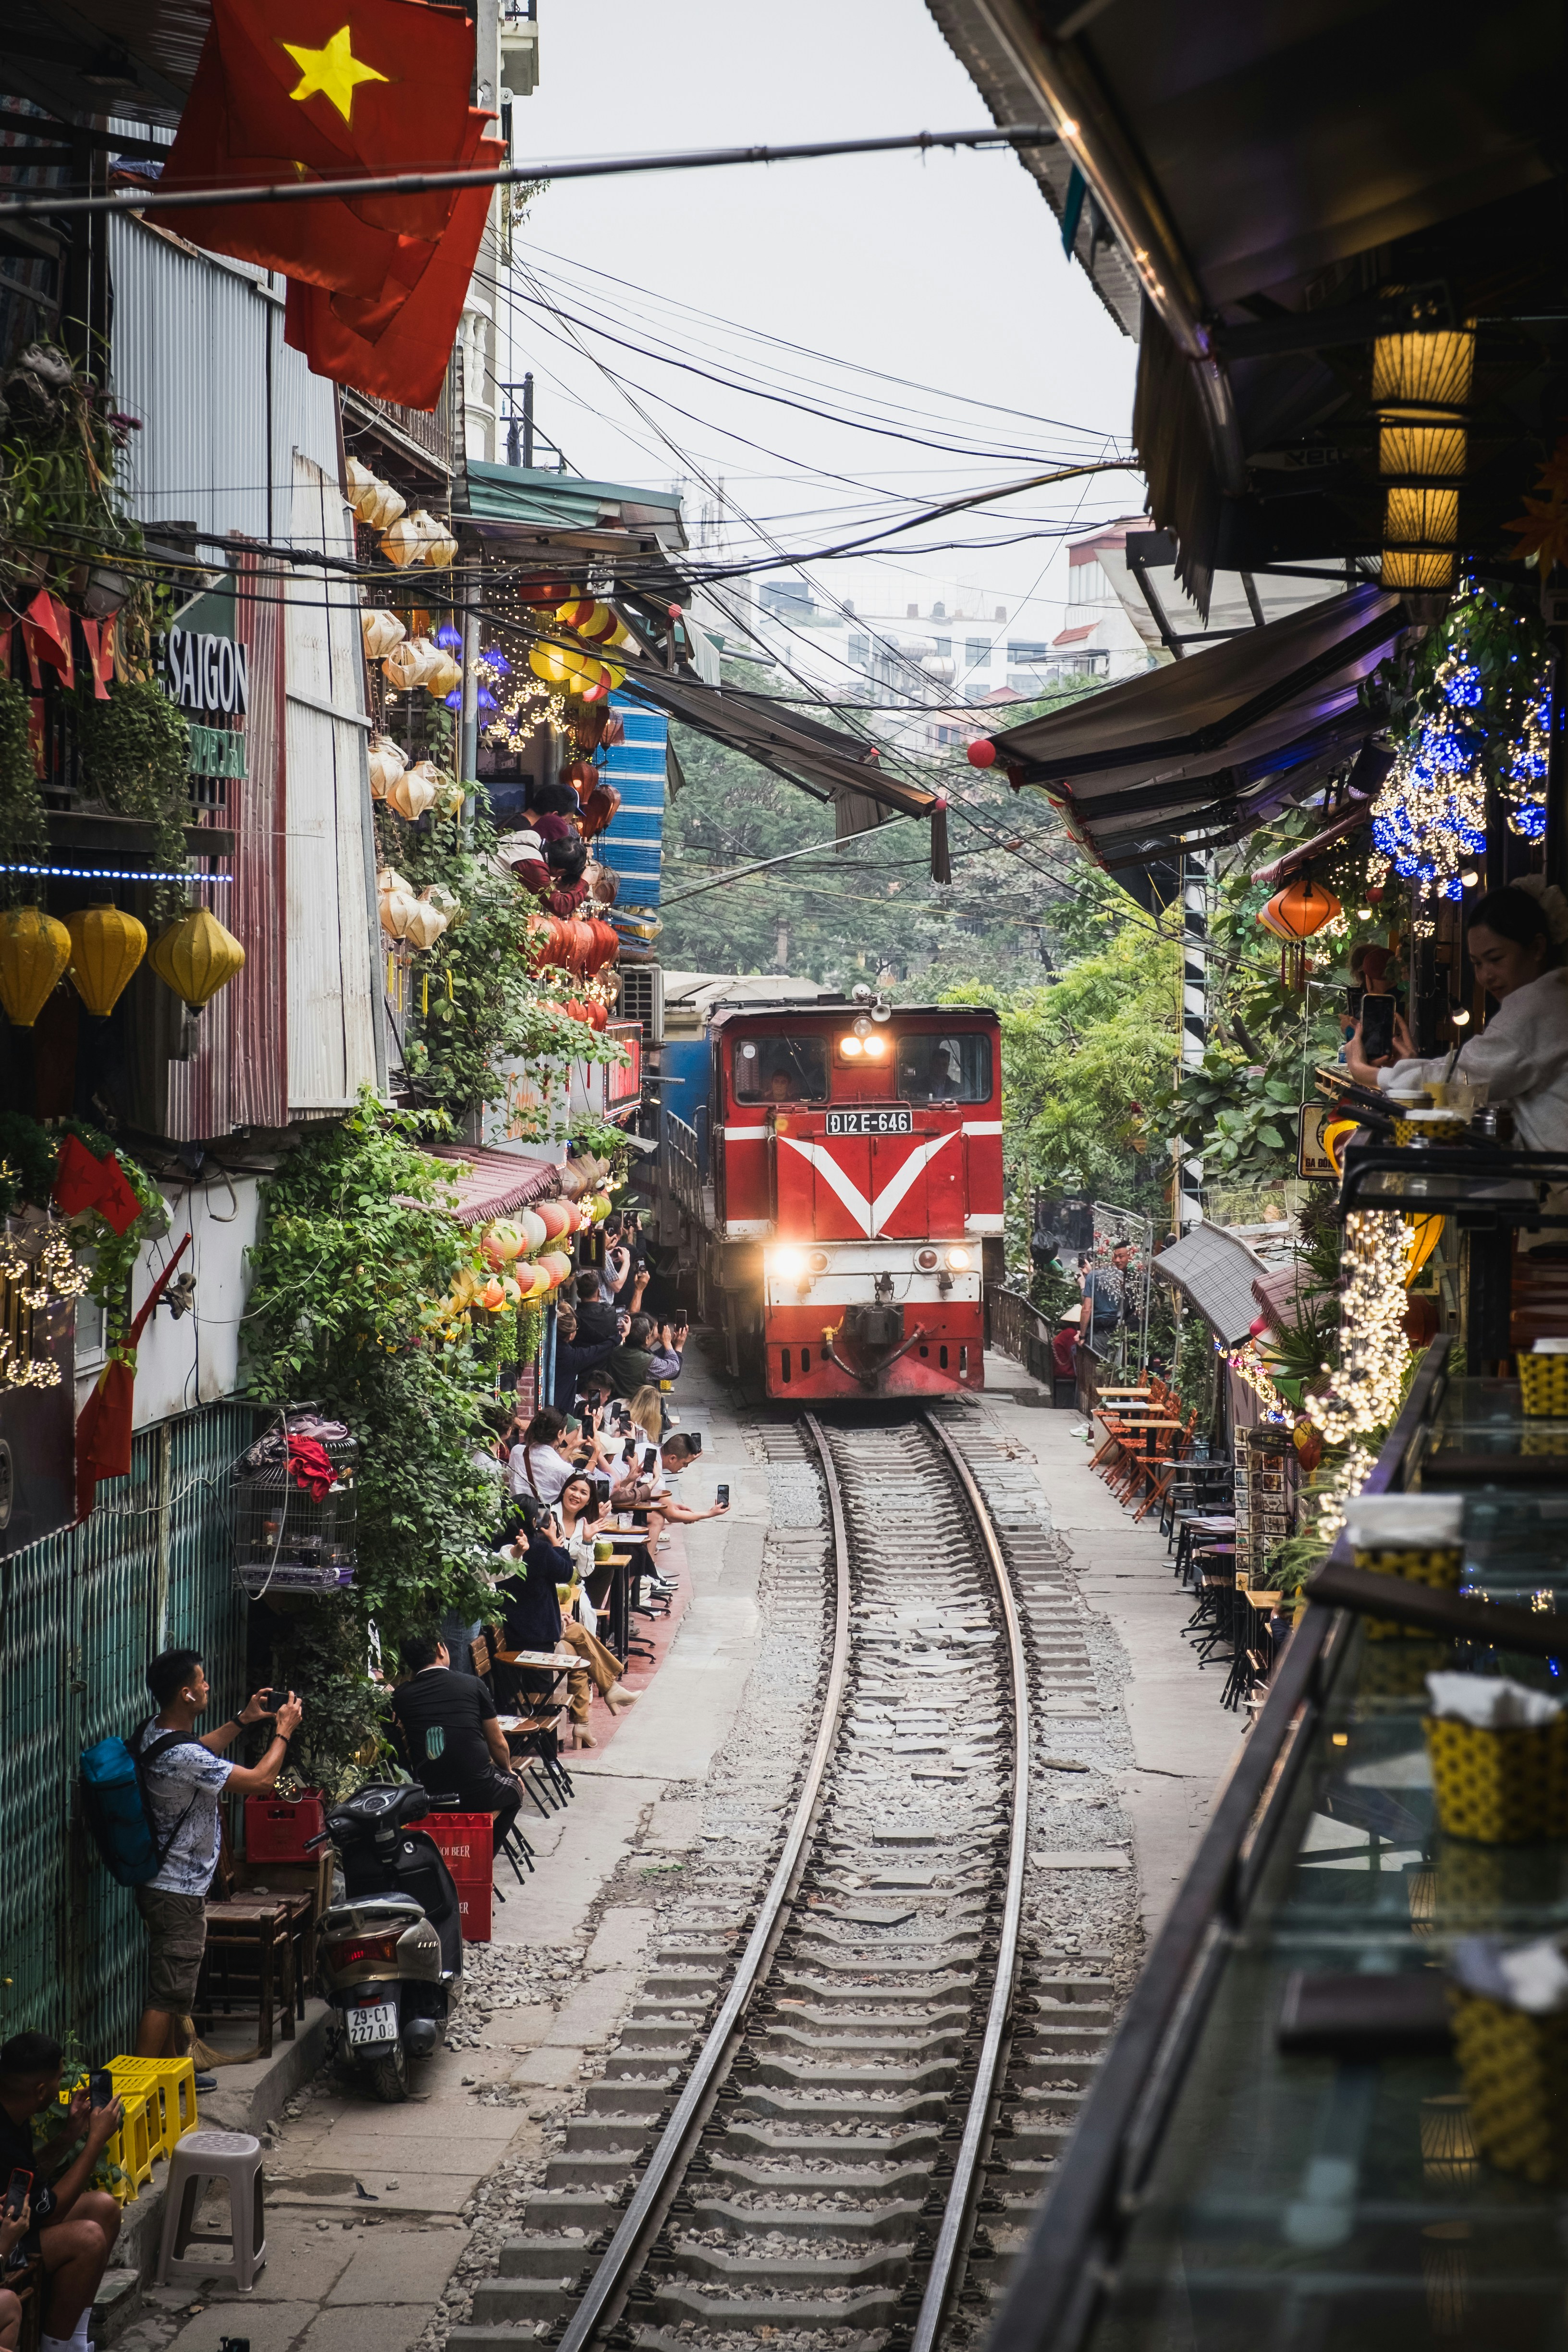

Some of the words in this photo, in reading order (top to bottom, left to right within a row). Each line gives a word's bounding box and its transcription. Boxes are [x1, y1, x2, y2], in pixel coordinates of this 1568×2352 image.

[170, 625, 249, 714] SAIGON
[190, 724, 249, 780] SPECIAL
[1306, 1158, 1316, 1167] GA
[1318, 1157, 1333, 1168] ĐÔN
[452, 1845, 470, 1858] BEER
[459, 1901, 469, 1915] ER
[353, 2007, 388, 2026] 29-C1
[351, 2023, 394, 2043] 227.08
